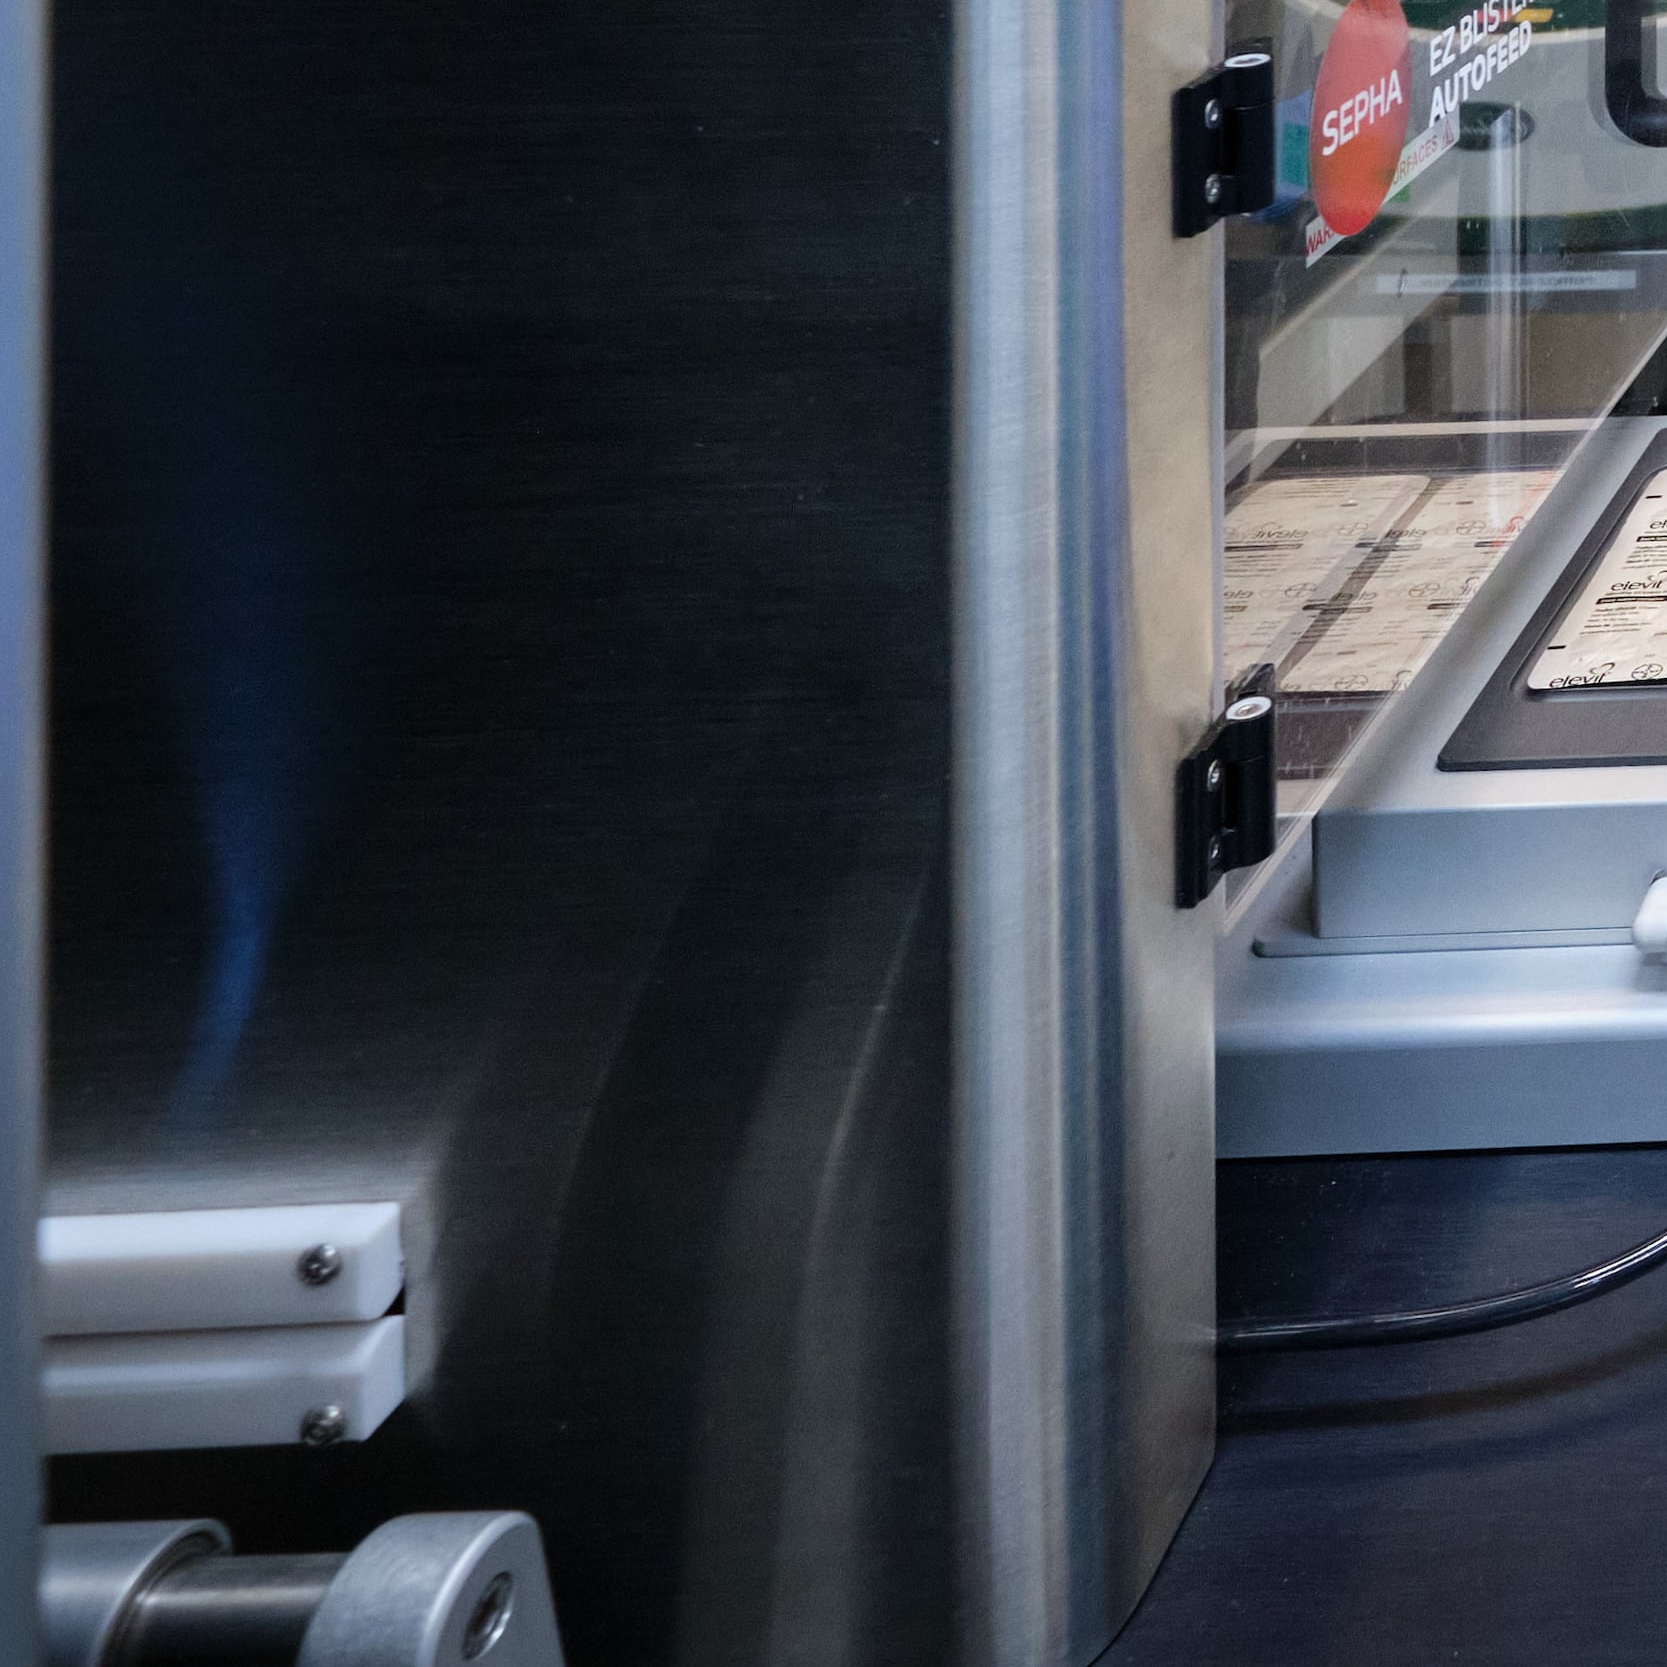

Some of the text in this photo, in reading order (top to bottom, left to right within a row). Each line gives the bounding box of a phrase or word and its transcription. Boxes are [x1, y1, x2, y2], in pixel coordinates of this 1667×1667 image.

[1429, 26, 1456, 77] EZ
[1429, 20, 1532, 128] AUTOFEED
[1321, 68, 1402, 156] SEPHA
[1393, 135, 1438, 184] URFACES
[1610, 579, 1663, 592] elevit
[1549, 672, 1606, 688] elevit
